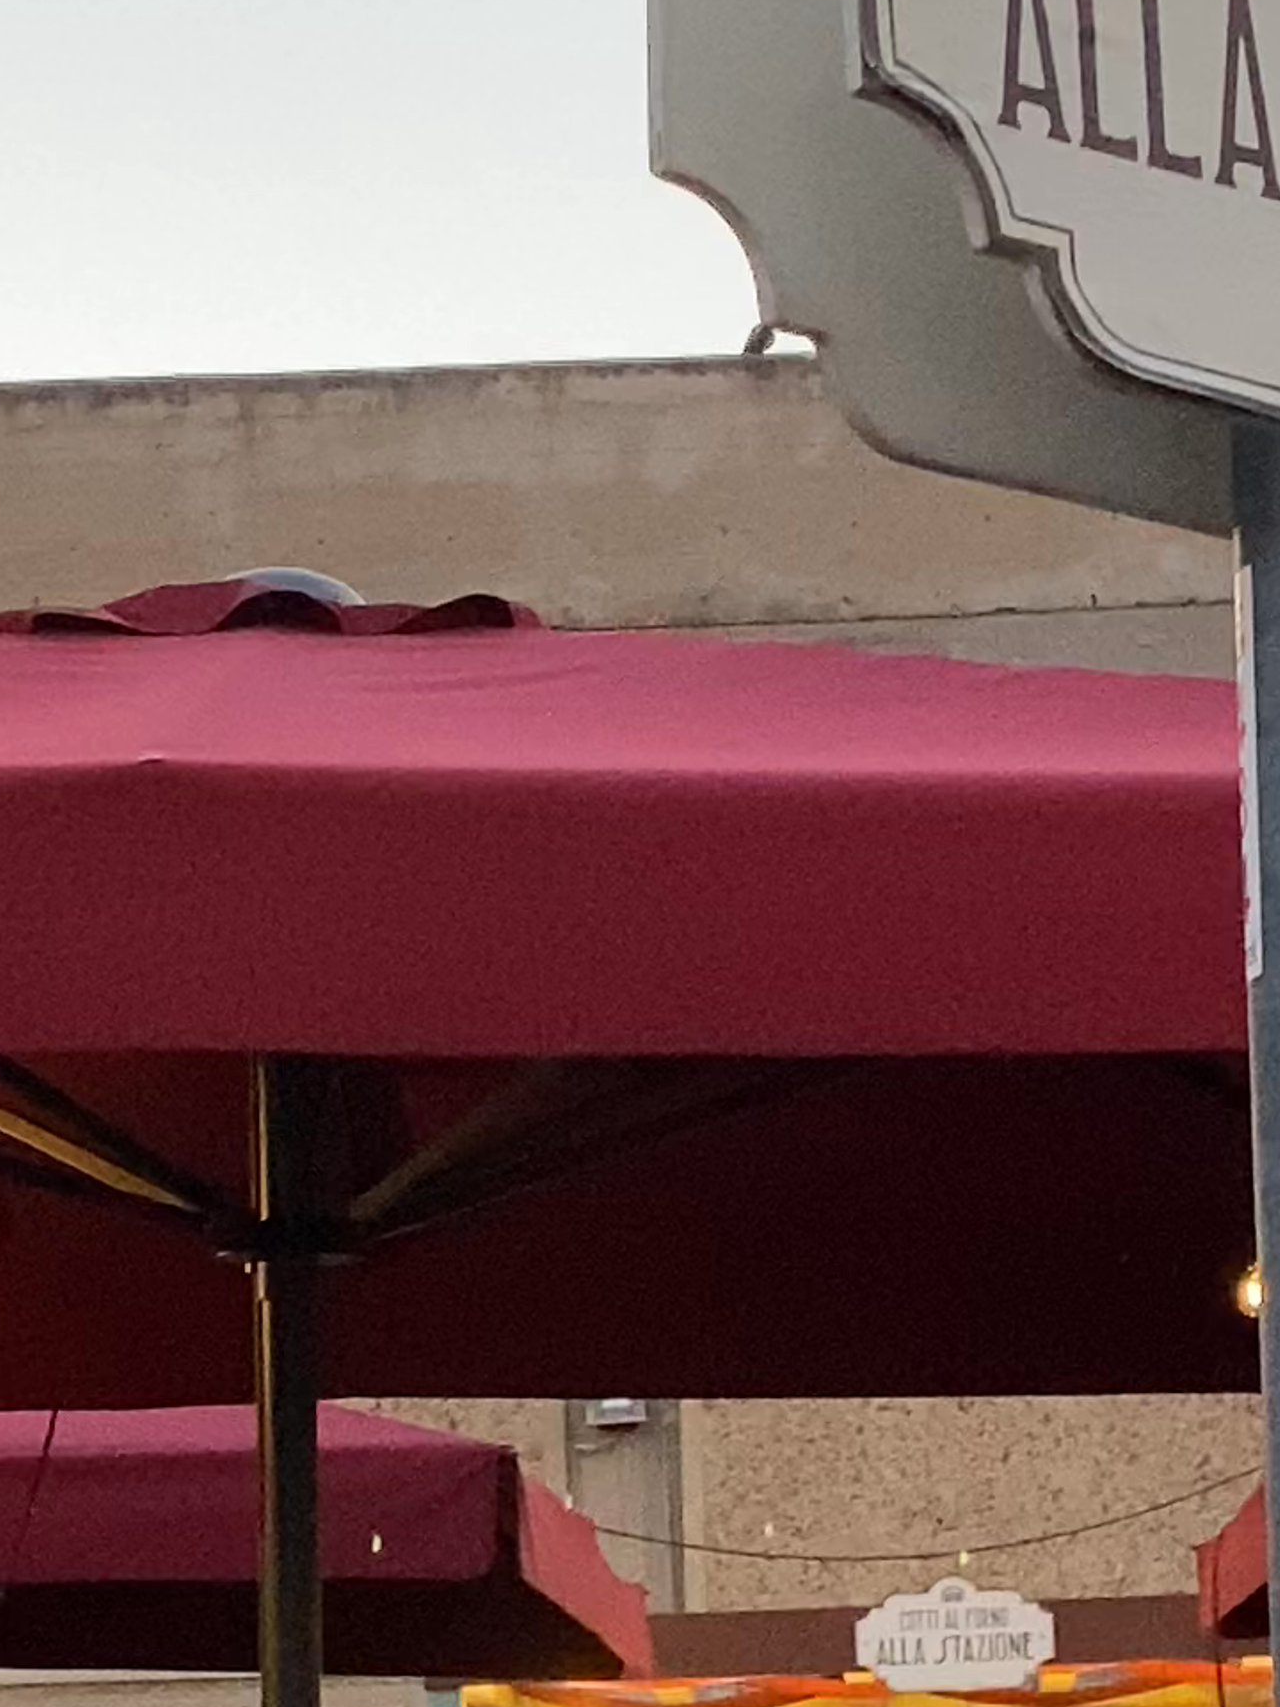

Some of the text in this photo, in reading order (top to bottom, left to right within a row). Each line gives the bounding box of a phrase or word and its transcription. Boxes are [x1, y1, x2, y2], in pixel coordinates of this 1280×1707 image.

[899, 1609, 939, 1631] COTTI
[945, 1608, 960, 1630] AL
[877, 1631, 1034, 1666] ALLA STAZIONE
